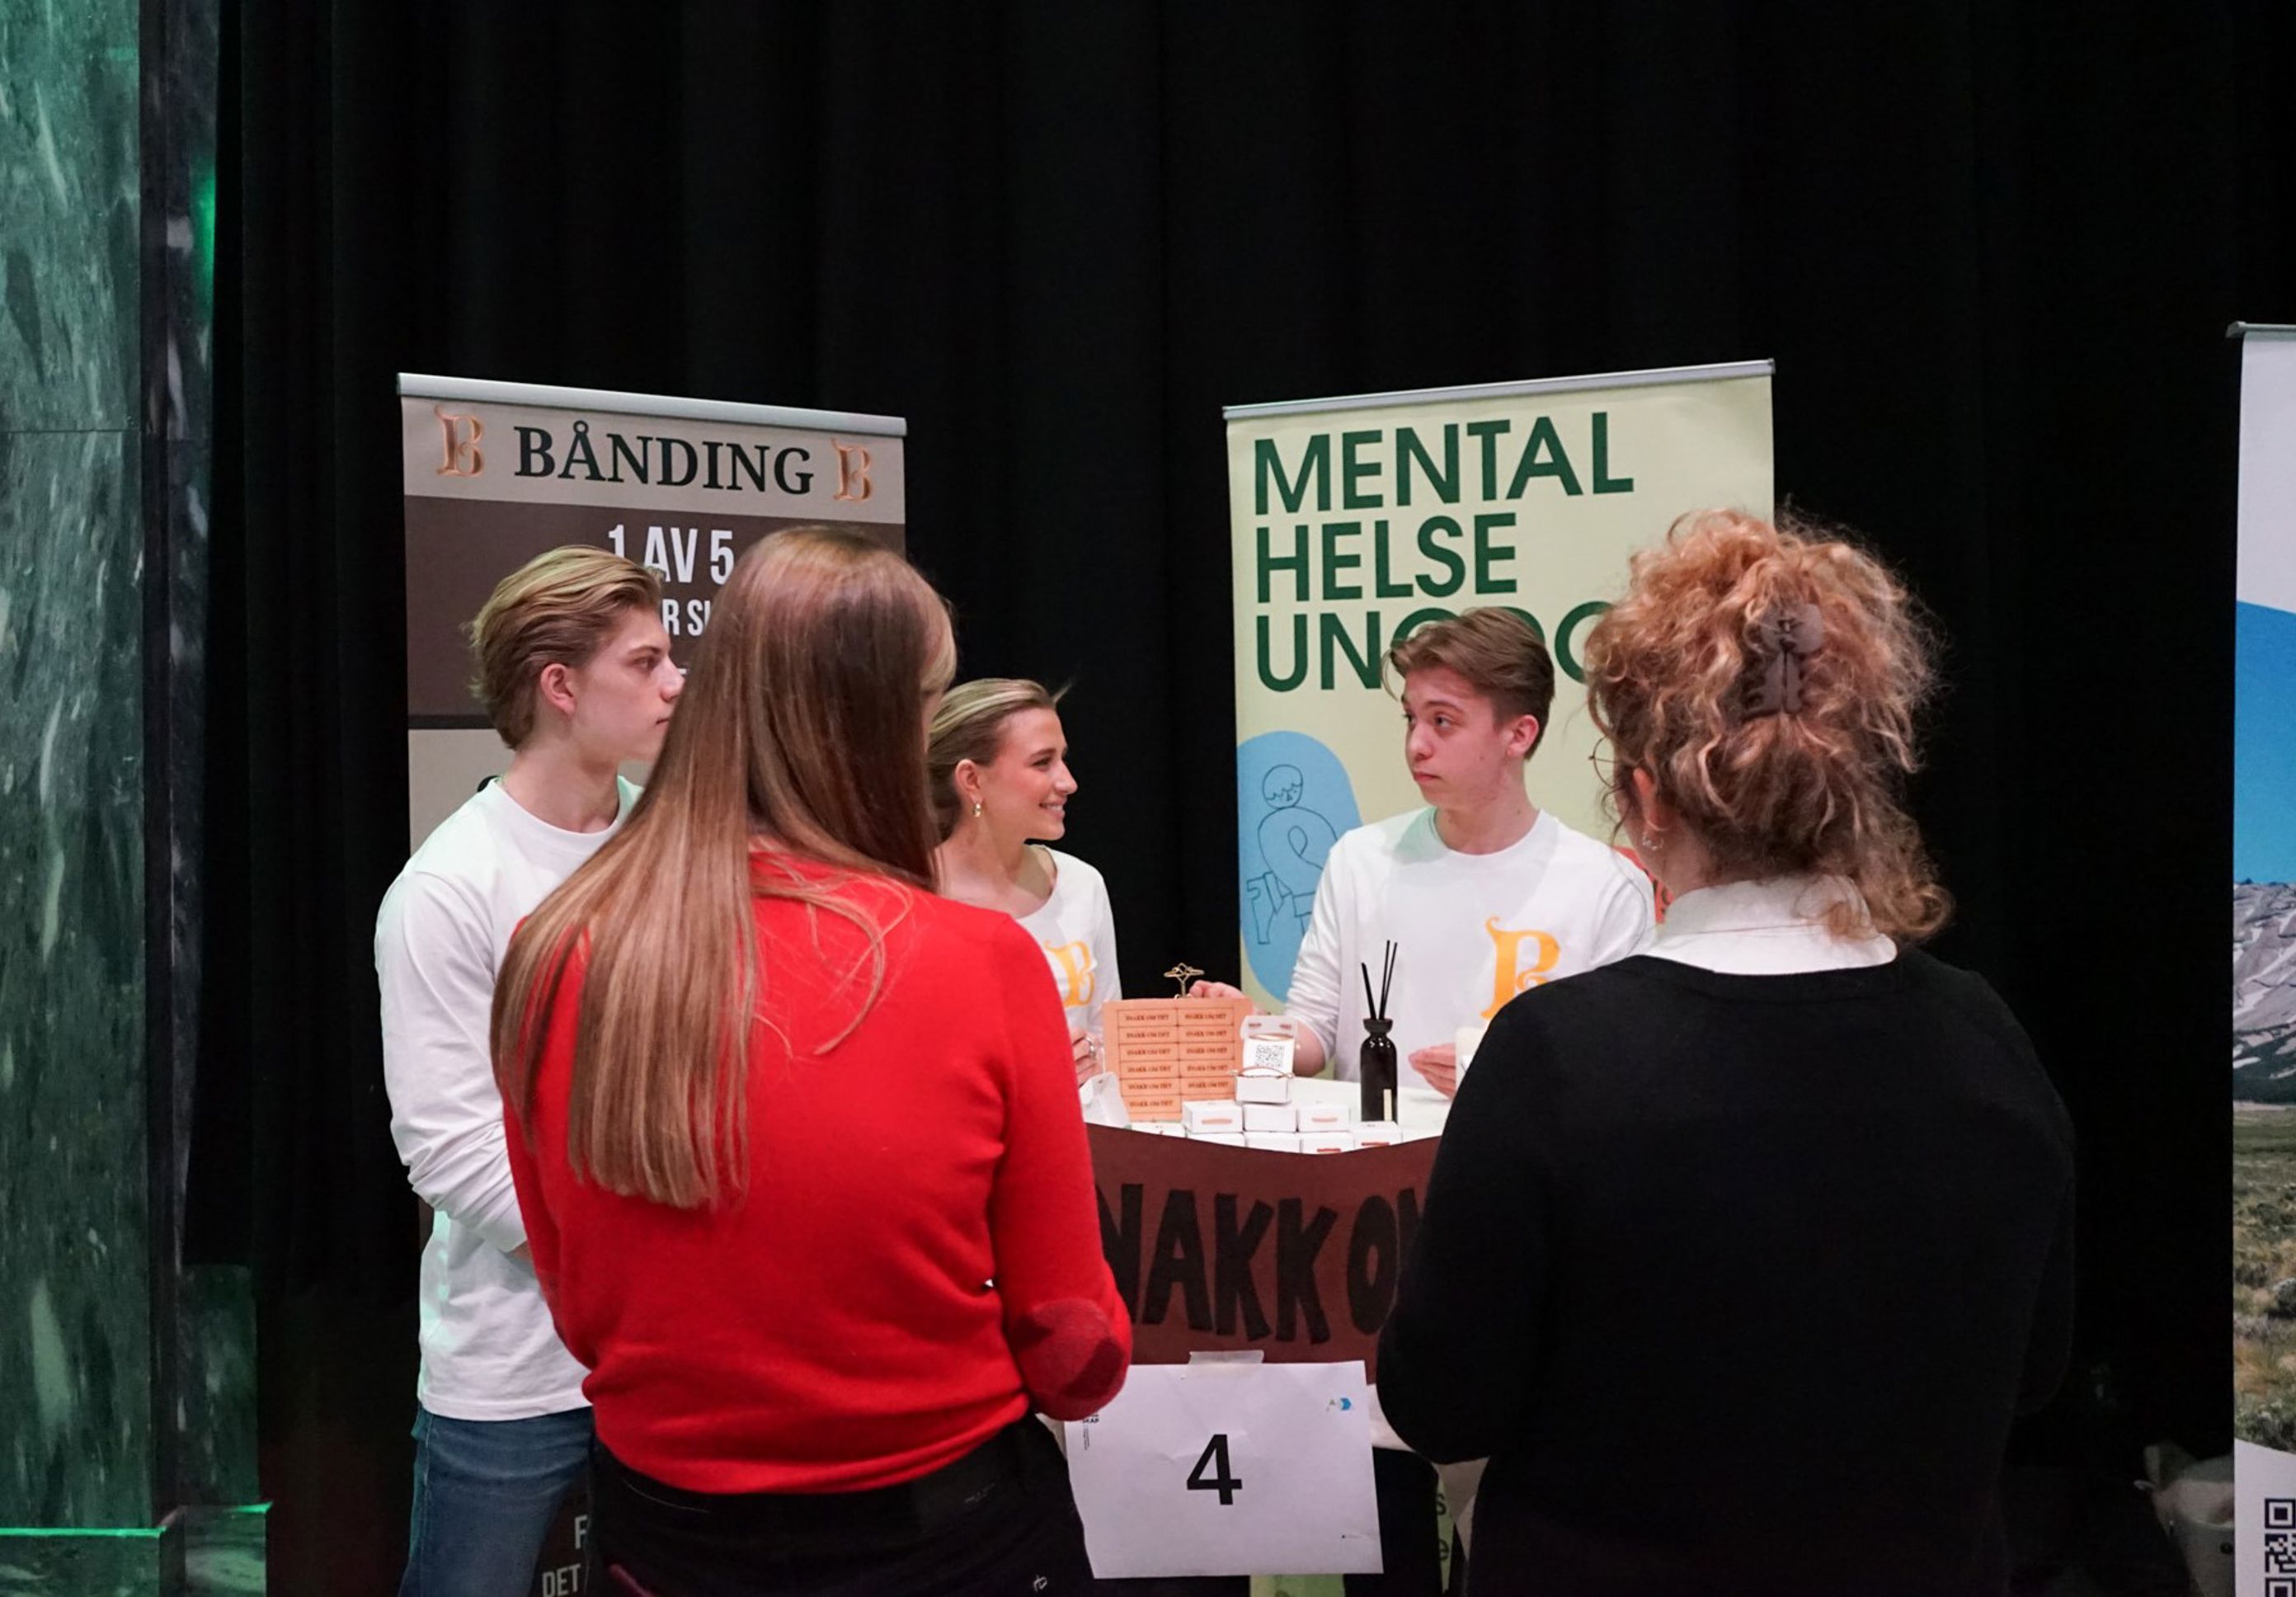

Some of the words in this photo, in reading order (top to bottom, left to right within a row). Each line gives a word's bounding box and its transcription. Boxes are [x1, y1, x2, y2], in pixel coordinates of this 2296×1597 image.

[514, 420, 814, 495] BÅNDING
[1254, 412, 1634, 516] MENTAL
[608, 524, 625, 559] 1
[643, 525, 699, 583] AV
[710, 529, 735, 586] 5
[1256, 512, 1517, 603] HELSE
[1096, 1184, 1338, 1345] NAKK
[1186, 1433, 1243, 1505] 4
